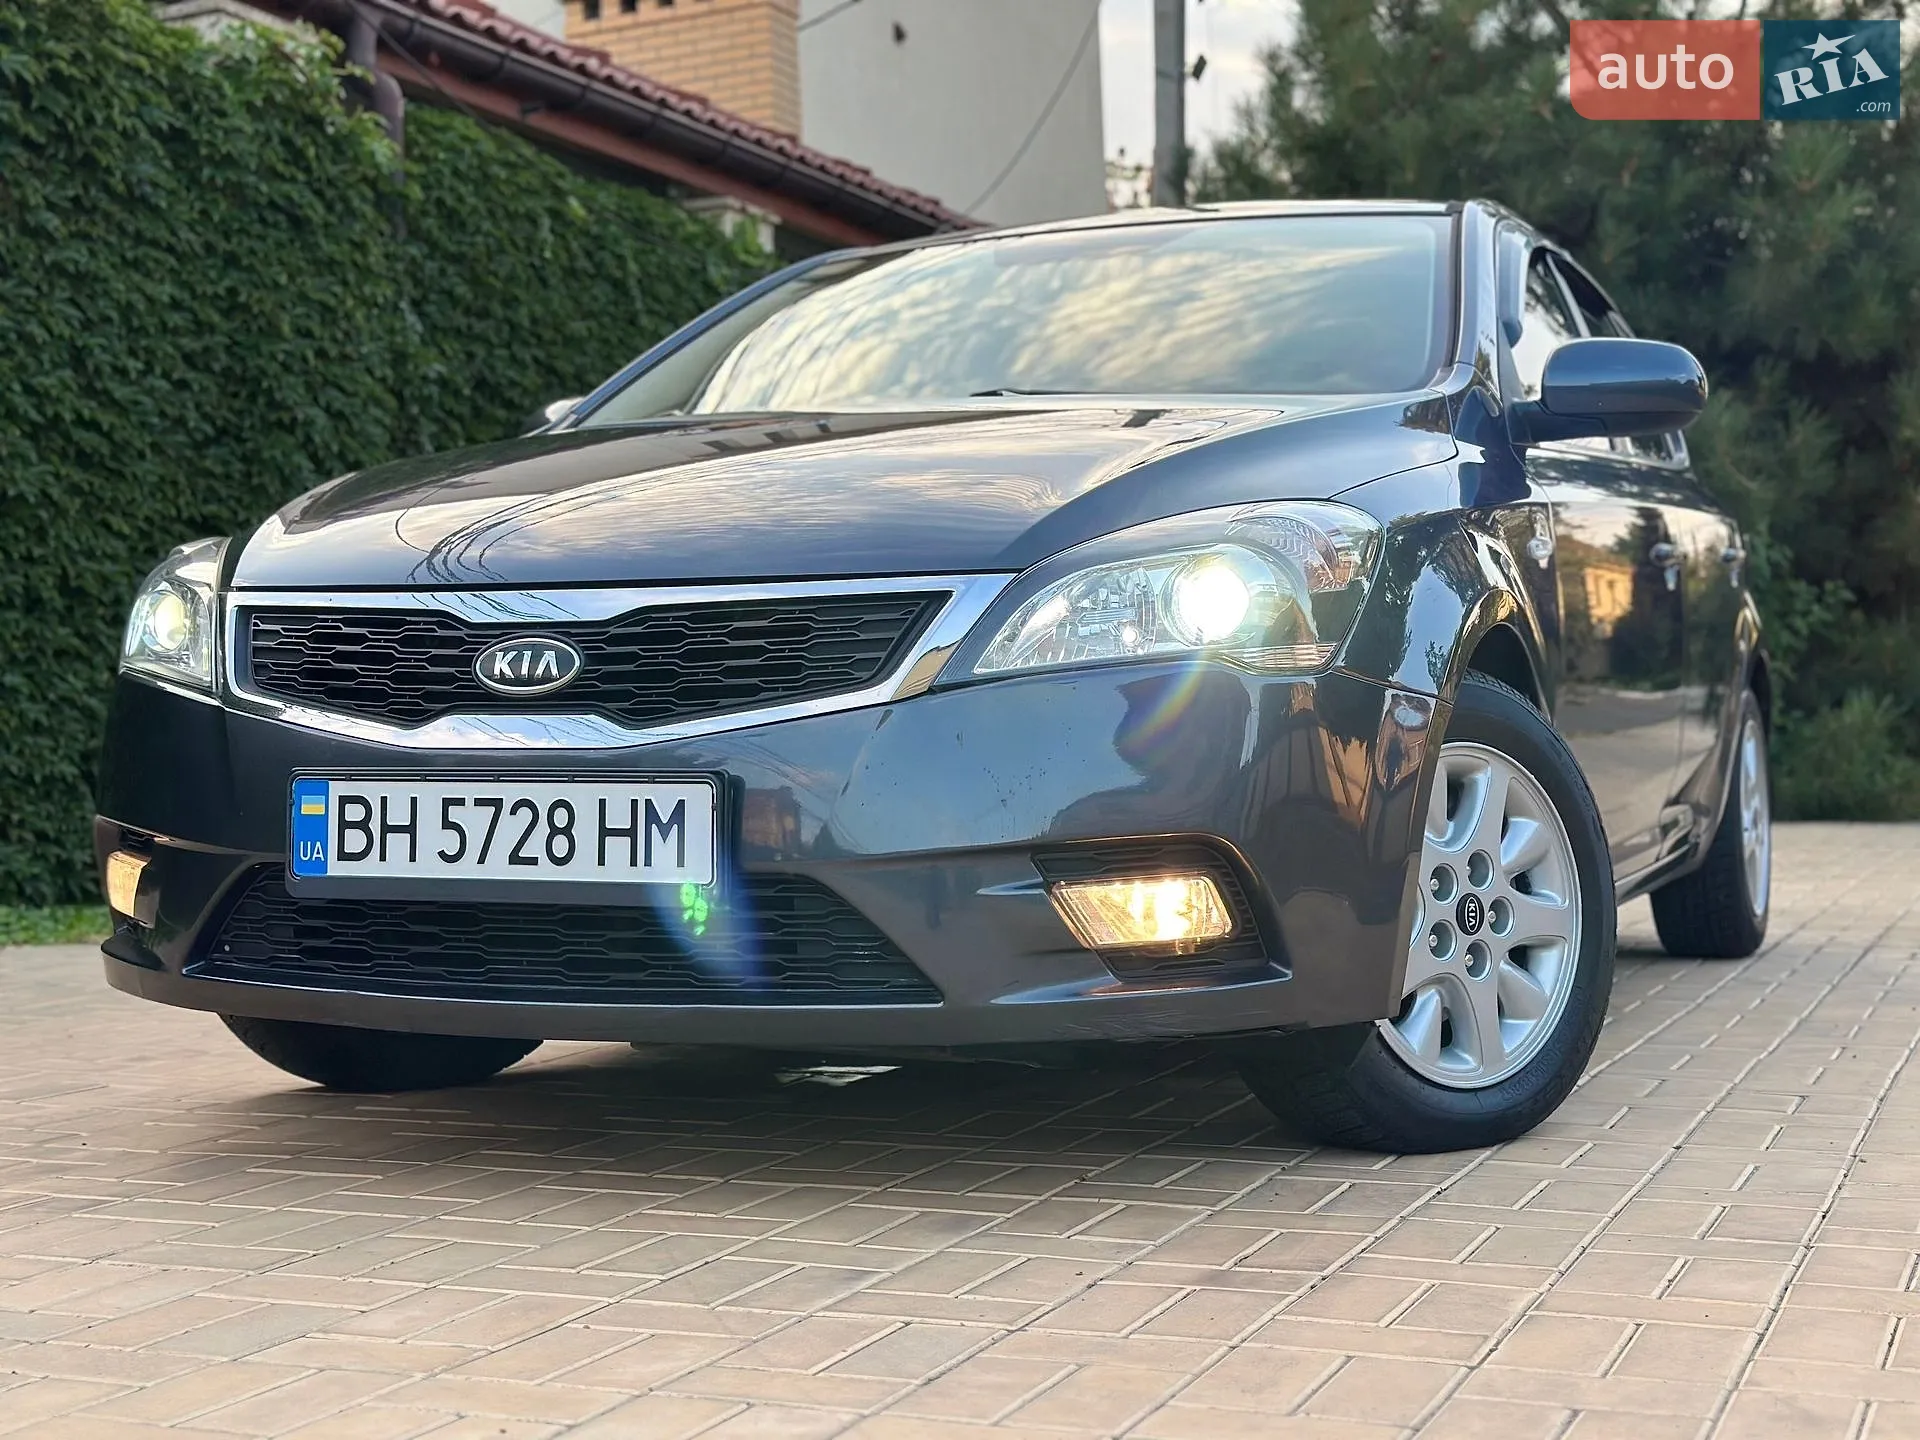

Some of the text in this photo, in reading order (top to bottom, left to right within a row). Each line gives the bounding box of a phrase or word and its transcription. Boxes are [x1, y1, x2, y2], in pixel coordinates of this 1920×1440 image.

[494, 650, 560, 679] KIA
[337, 795, 686, 868] BH 5728 HM
[299, 840, 325, 862] UA
[1468, 903, 1476, 926] KIA
